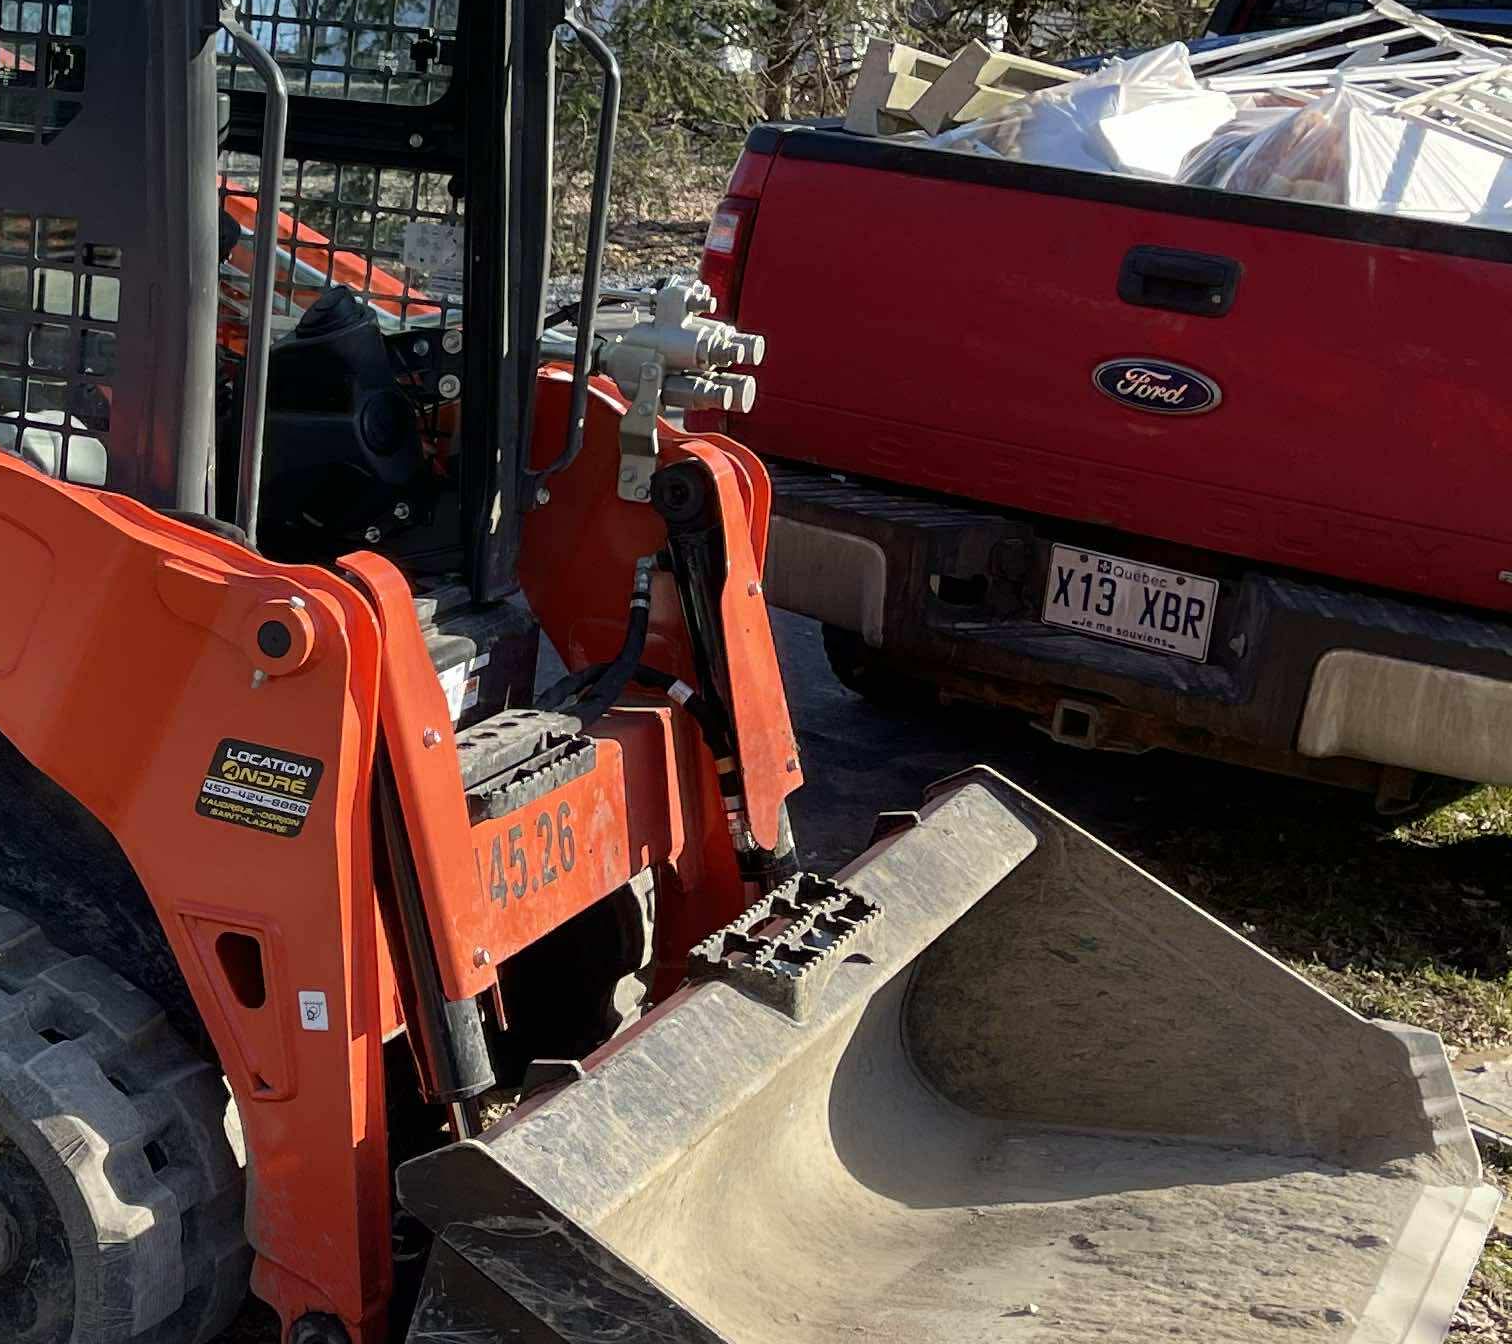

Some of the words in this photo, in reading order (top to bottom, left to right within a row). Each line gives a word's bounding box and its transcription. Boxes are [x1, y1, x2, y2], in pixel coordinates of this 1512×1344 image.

[1116, 367, 1189, 405] Ford
[1052, 566, 1118, 617] X13
[1138, 586, 1206, 640] XBR
[1115, 627, 1169, 646] souviens
[226, 747, 313, 777] LOCATION
